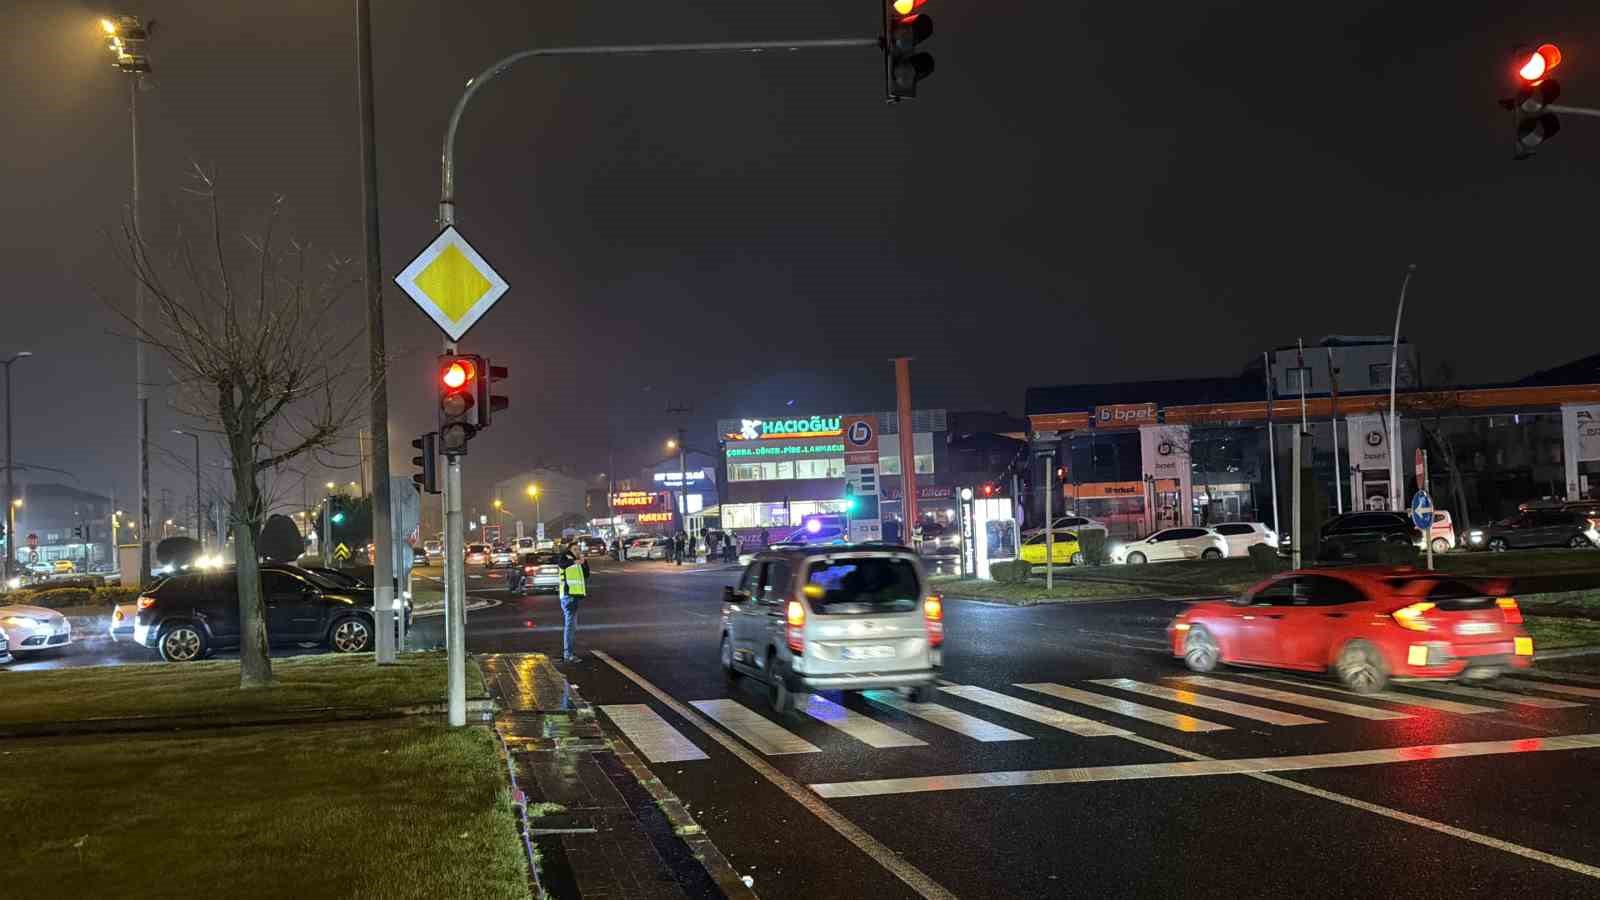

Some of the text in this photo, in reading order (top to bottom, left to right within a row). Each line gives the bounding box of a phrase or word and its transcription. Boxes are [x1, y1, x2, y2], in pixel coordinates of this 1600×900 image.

[1114, 404, 1152, 421] bpet
[804, 443, 845, 453] LAHMACU
[612, 496, 653, 506] MARKET
[638, 512, 672, 522] MARKET
